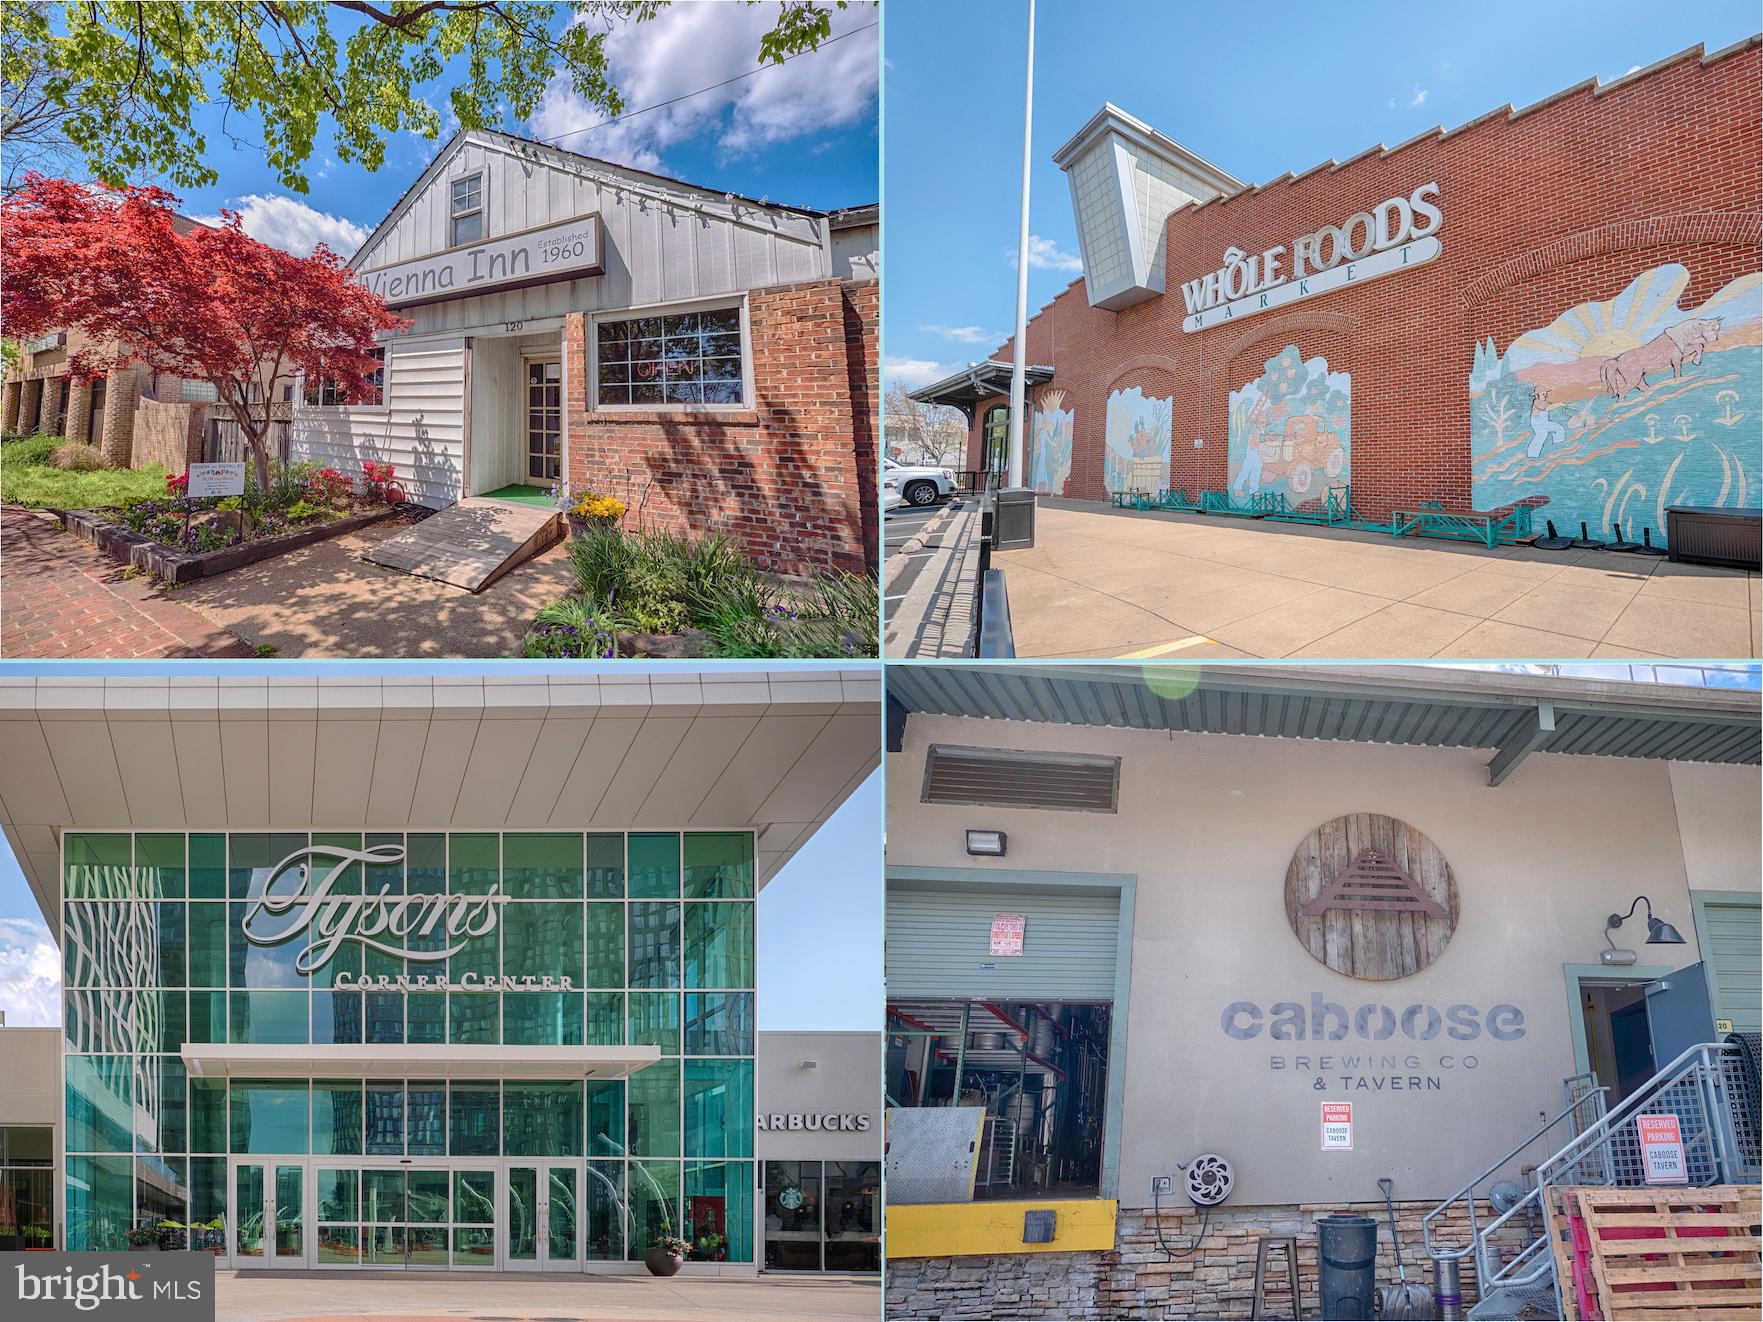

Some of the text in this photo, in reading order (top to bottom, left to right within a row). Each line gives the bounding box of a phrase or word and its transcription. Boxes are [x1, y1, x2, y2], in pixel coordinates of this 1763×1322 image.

[537, 229, 589, 249] Established
[1181, 181, 1443, 315] WHOLE FOODS
[541, 241, 585, 264] 1960
[365, 247, 531, 298] Vienna Inn
[1194, 246, 1412, 328] MARKET
[505, 321, 523, 332] 120
[241, 844, 499, 973] Tysons
[1220, 992, 1527, 1041] caboose
[1270, 1056, 1422, 1070] BREWING
[1312, 1076, 1442, 1091] & TAVERN
[758, 1113, 872, 1131] ARBUCKS
[1642, 1119, 1676, 1129] RESERVED
[1646, 1131, 1676, 1142] PARKING
[1649, 1150, 1679, 1160] CABOOSE
[1653, 1161, 1678, 1170] TAVERN
